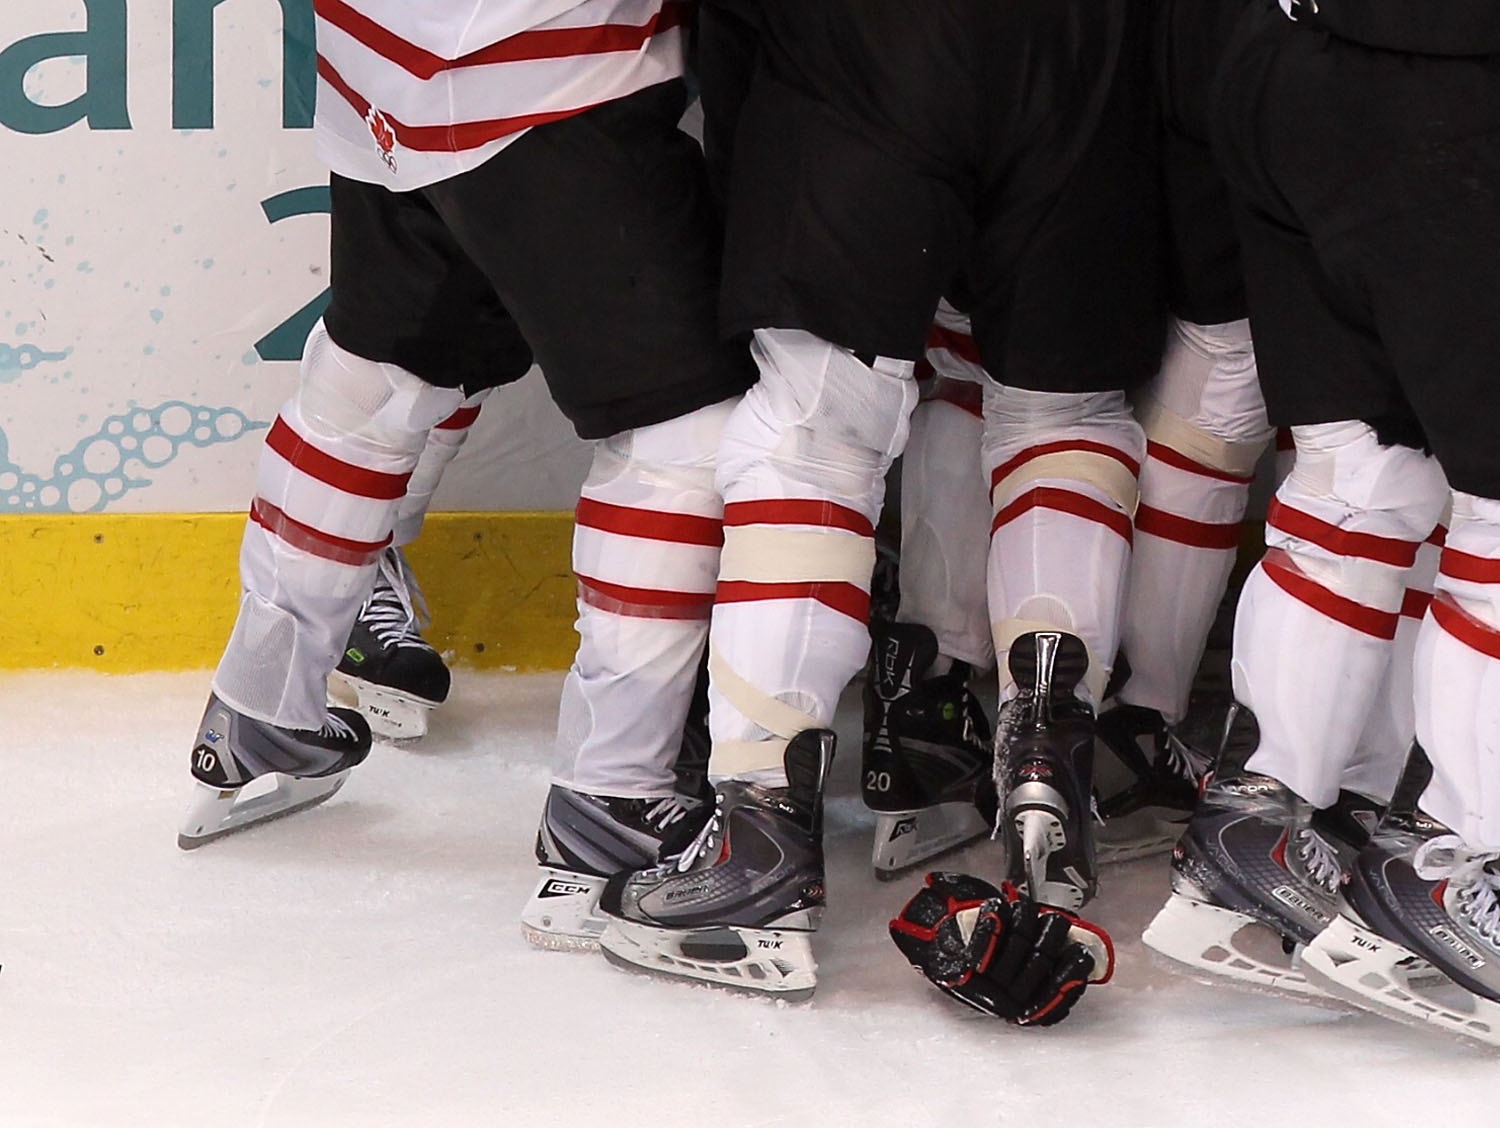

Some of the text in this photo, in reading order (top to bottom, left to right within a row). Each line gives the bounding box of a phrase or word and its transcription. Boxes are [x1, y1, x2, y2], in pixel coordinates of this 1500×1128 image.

[196, 748, 217, 772] 10
[866, 769, 892, 793] 20
[549, 880, 592, 895] CCM
